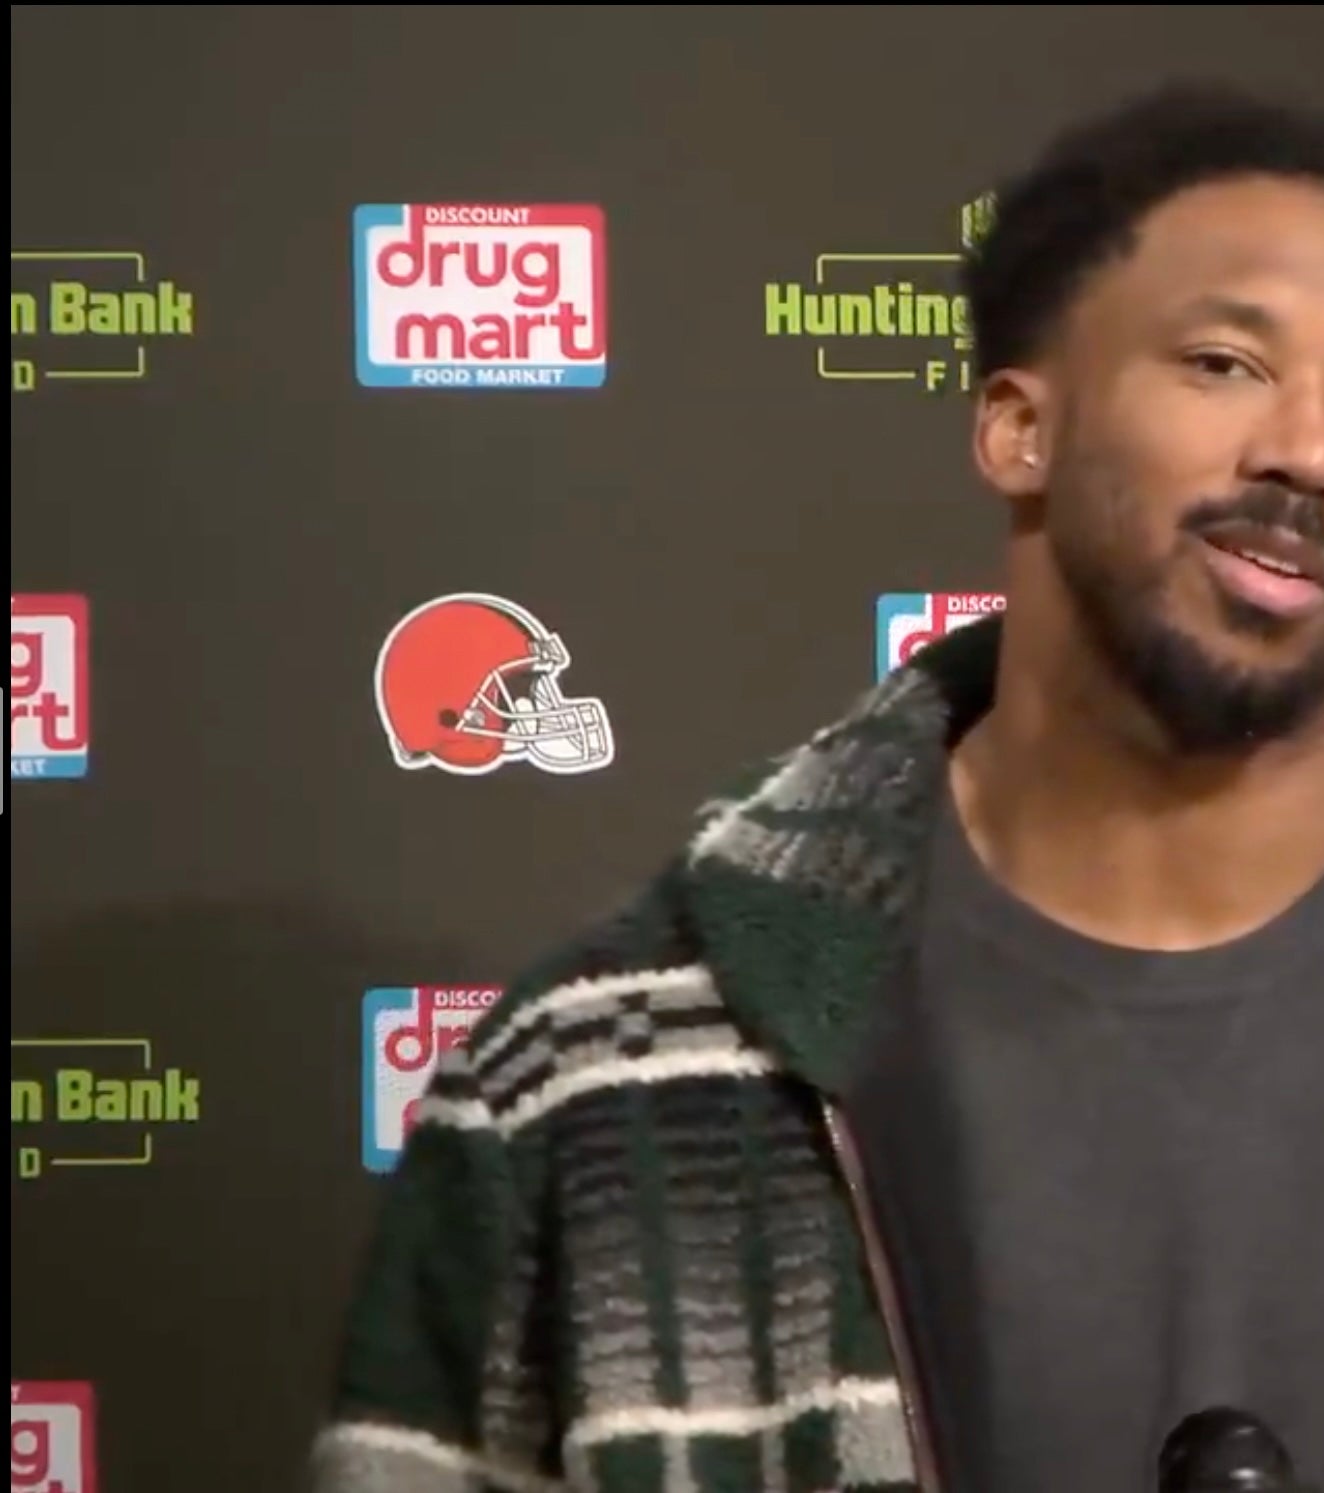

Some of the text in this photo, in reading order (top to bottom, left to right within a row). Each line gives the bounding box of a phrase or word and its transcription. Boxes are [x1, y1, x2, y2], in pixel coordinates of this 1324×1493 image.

[425, 207, 531, 224] DISCOUNT
[377, 205, 560, 308] drug
[51, 281, 192, 334] Bank
[395, 302, 603, 360] mart
[765, 282, 973, 349] Hunting
[412, 368, 566, 385] FOOD MARKET
[947, 596, 1007, 612] DISCO
[434, 990, 498, 1007] DISCO
[57, 1068, 199, 1121] Bank
